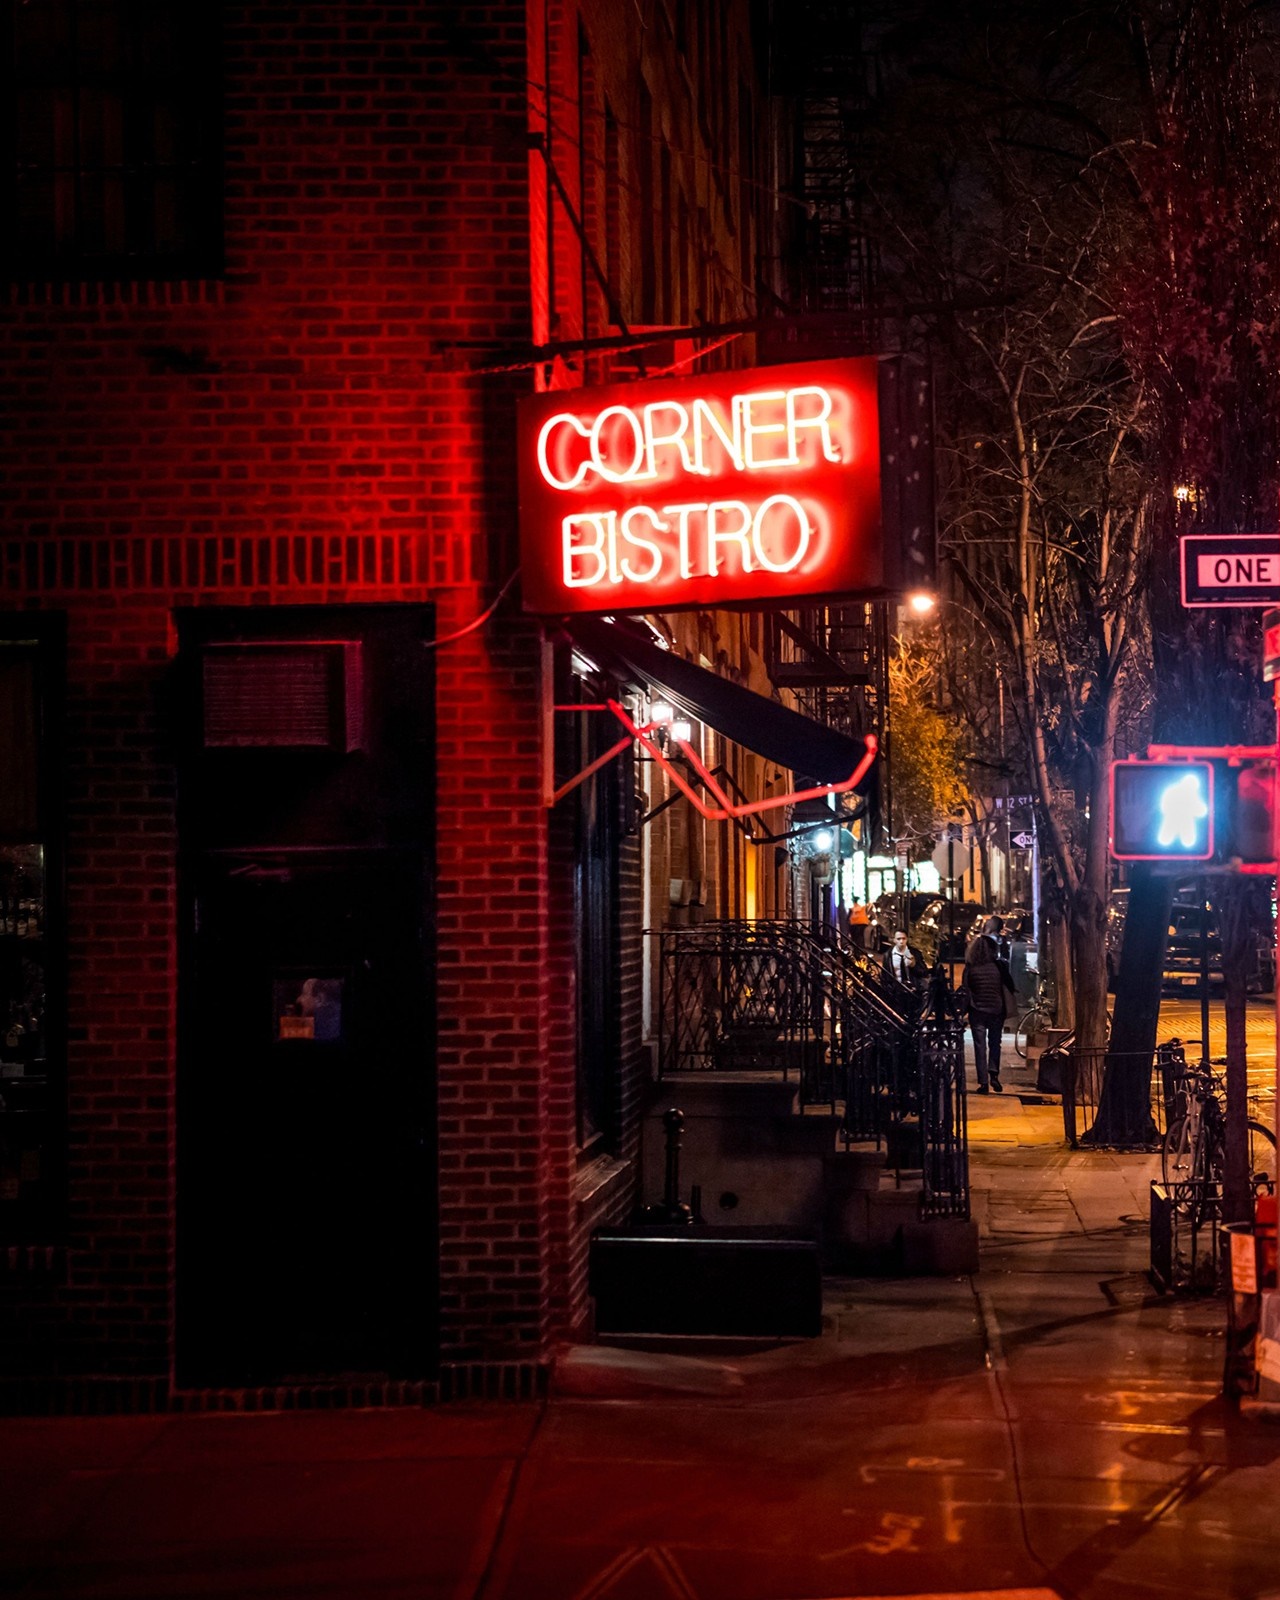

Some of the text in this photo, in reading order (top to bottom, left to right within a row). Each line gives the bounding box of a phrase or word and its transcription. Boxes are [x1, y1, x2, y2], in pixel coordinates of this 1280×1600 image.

[537, 386, 843, 490] CORNER
[562, 494, 810, 588] BISTRO
[1214, 558, 1272, 583] ONE
[1019, 836, 1032, 844] ON
